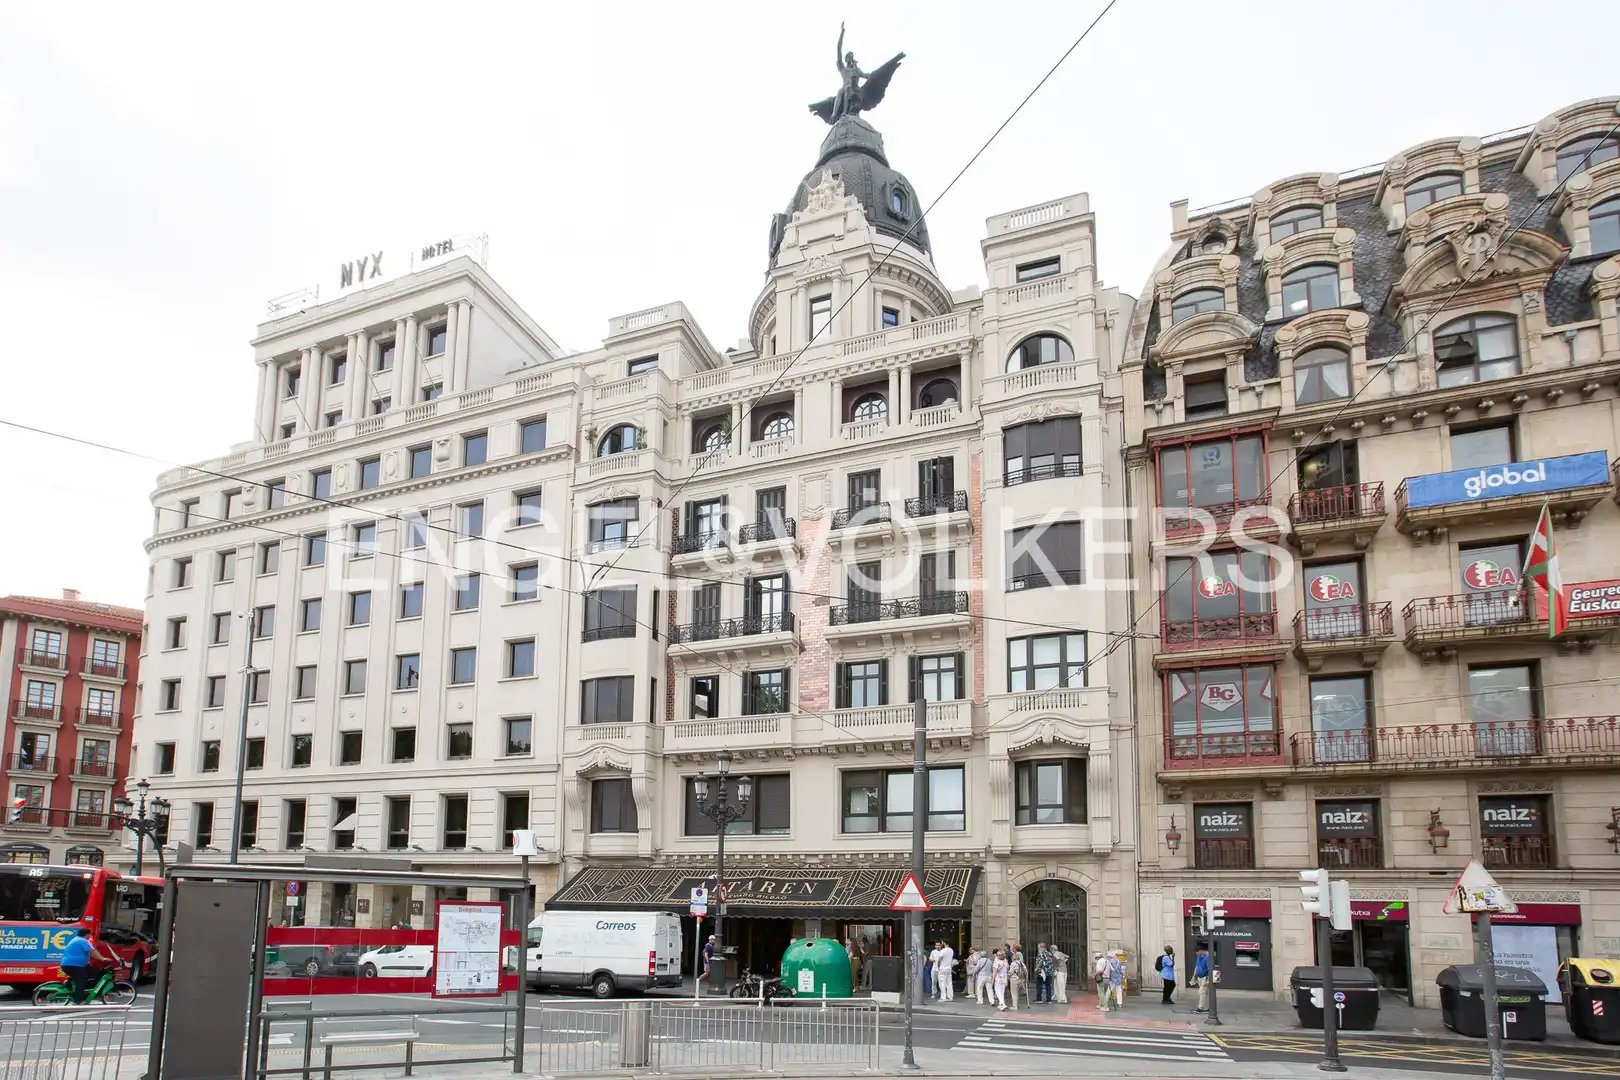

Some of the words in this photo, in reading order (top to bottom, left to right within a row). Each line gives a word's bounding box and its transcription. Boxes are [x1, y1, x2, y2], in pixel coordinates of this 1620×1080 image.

[340, 251, 383, 288] NYX
[421, 238, 455, 261] HOTEL
[1464, 462, 1546, 497] global
[1484, 567, 1517, 587] EA
[1213, 581, 1236, 596] EA
[1327, 582, 1355, 600] EA
[1208, 686, 1235, 701] BG
[596, 920, 636, 931] Correos
